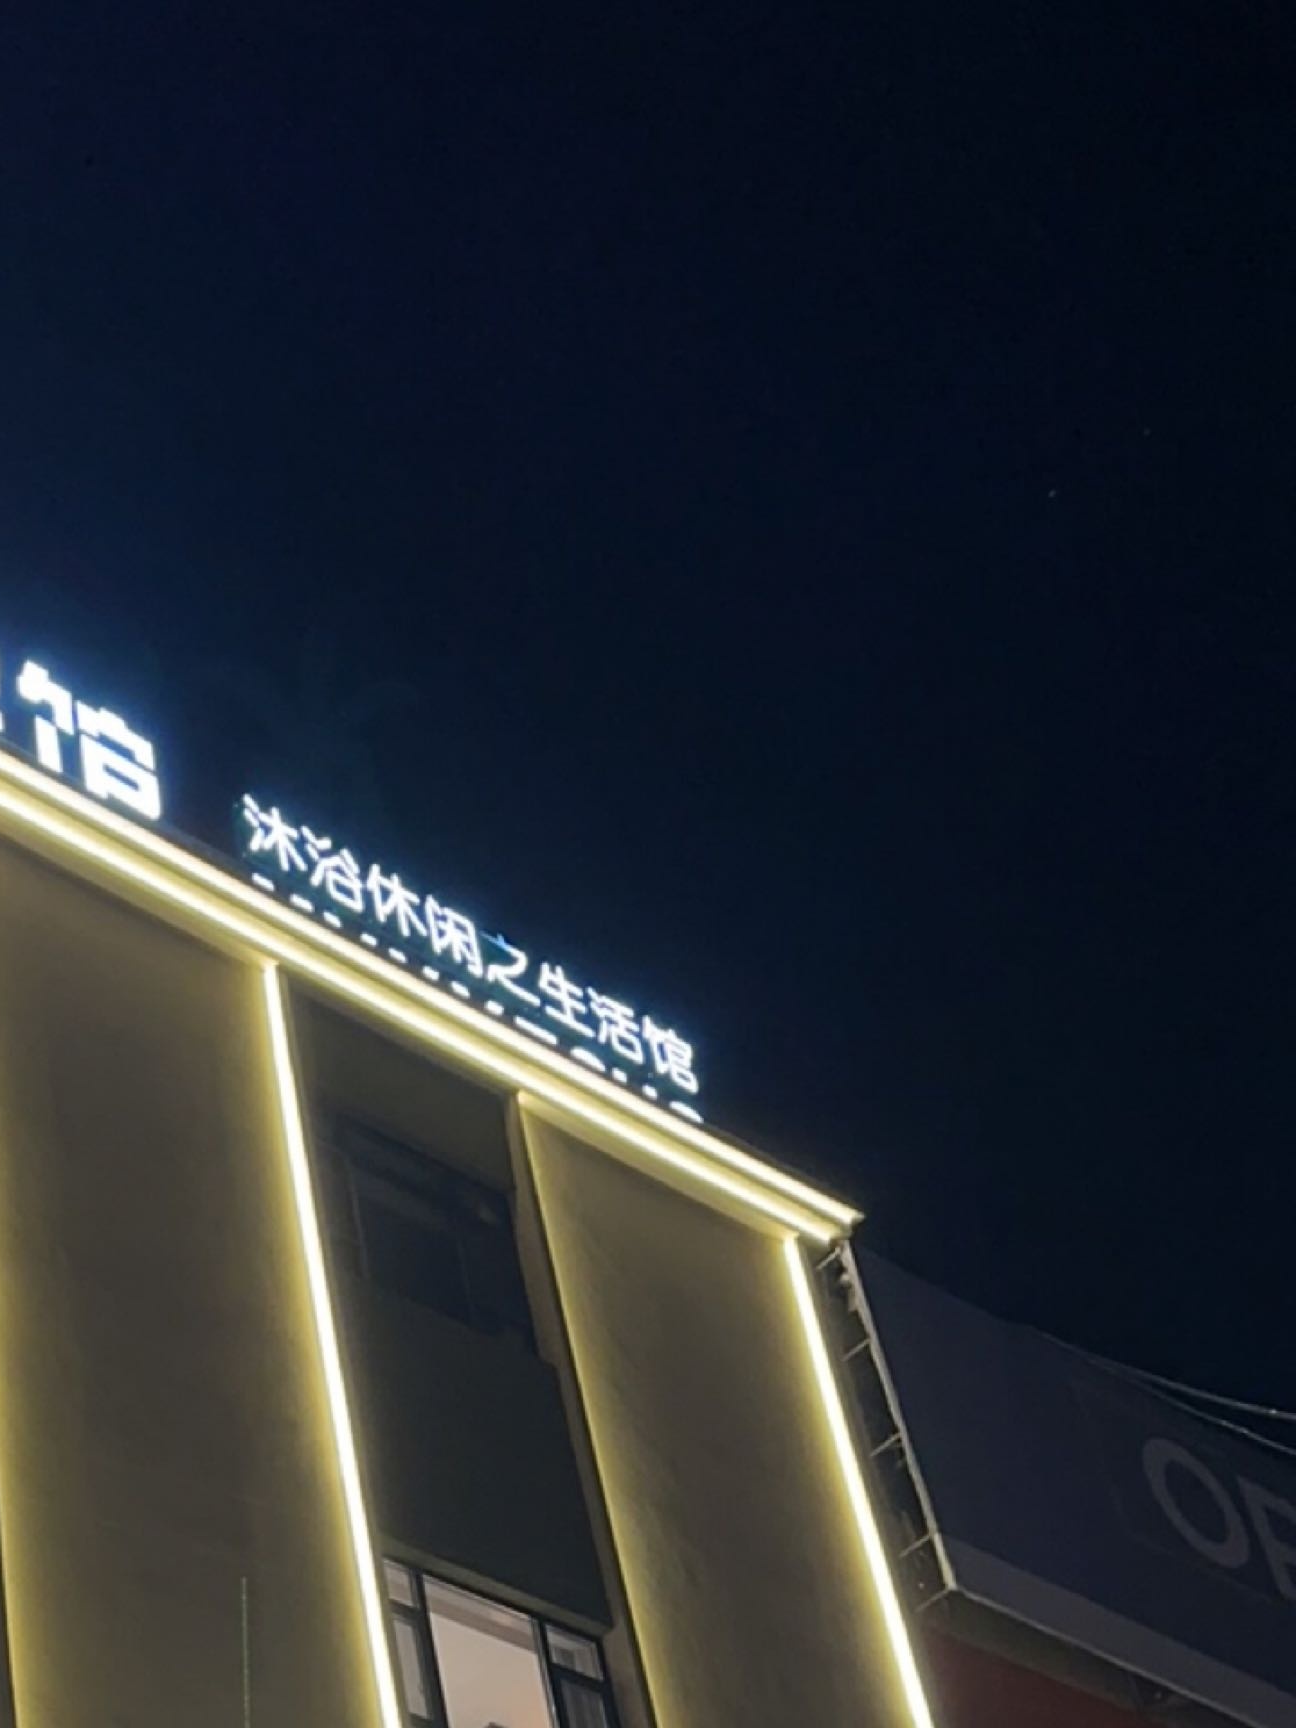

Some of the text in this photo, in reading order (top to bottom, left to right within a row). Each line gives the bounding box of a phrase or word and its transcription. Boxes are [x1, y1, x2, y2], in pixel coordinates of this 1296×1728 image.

[242, 793, 699, 1094] 沐浴休闲之生活馆
